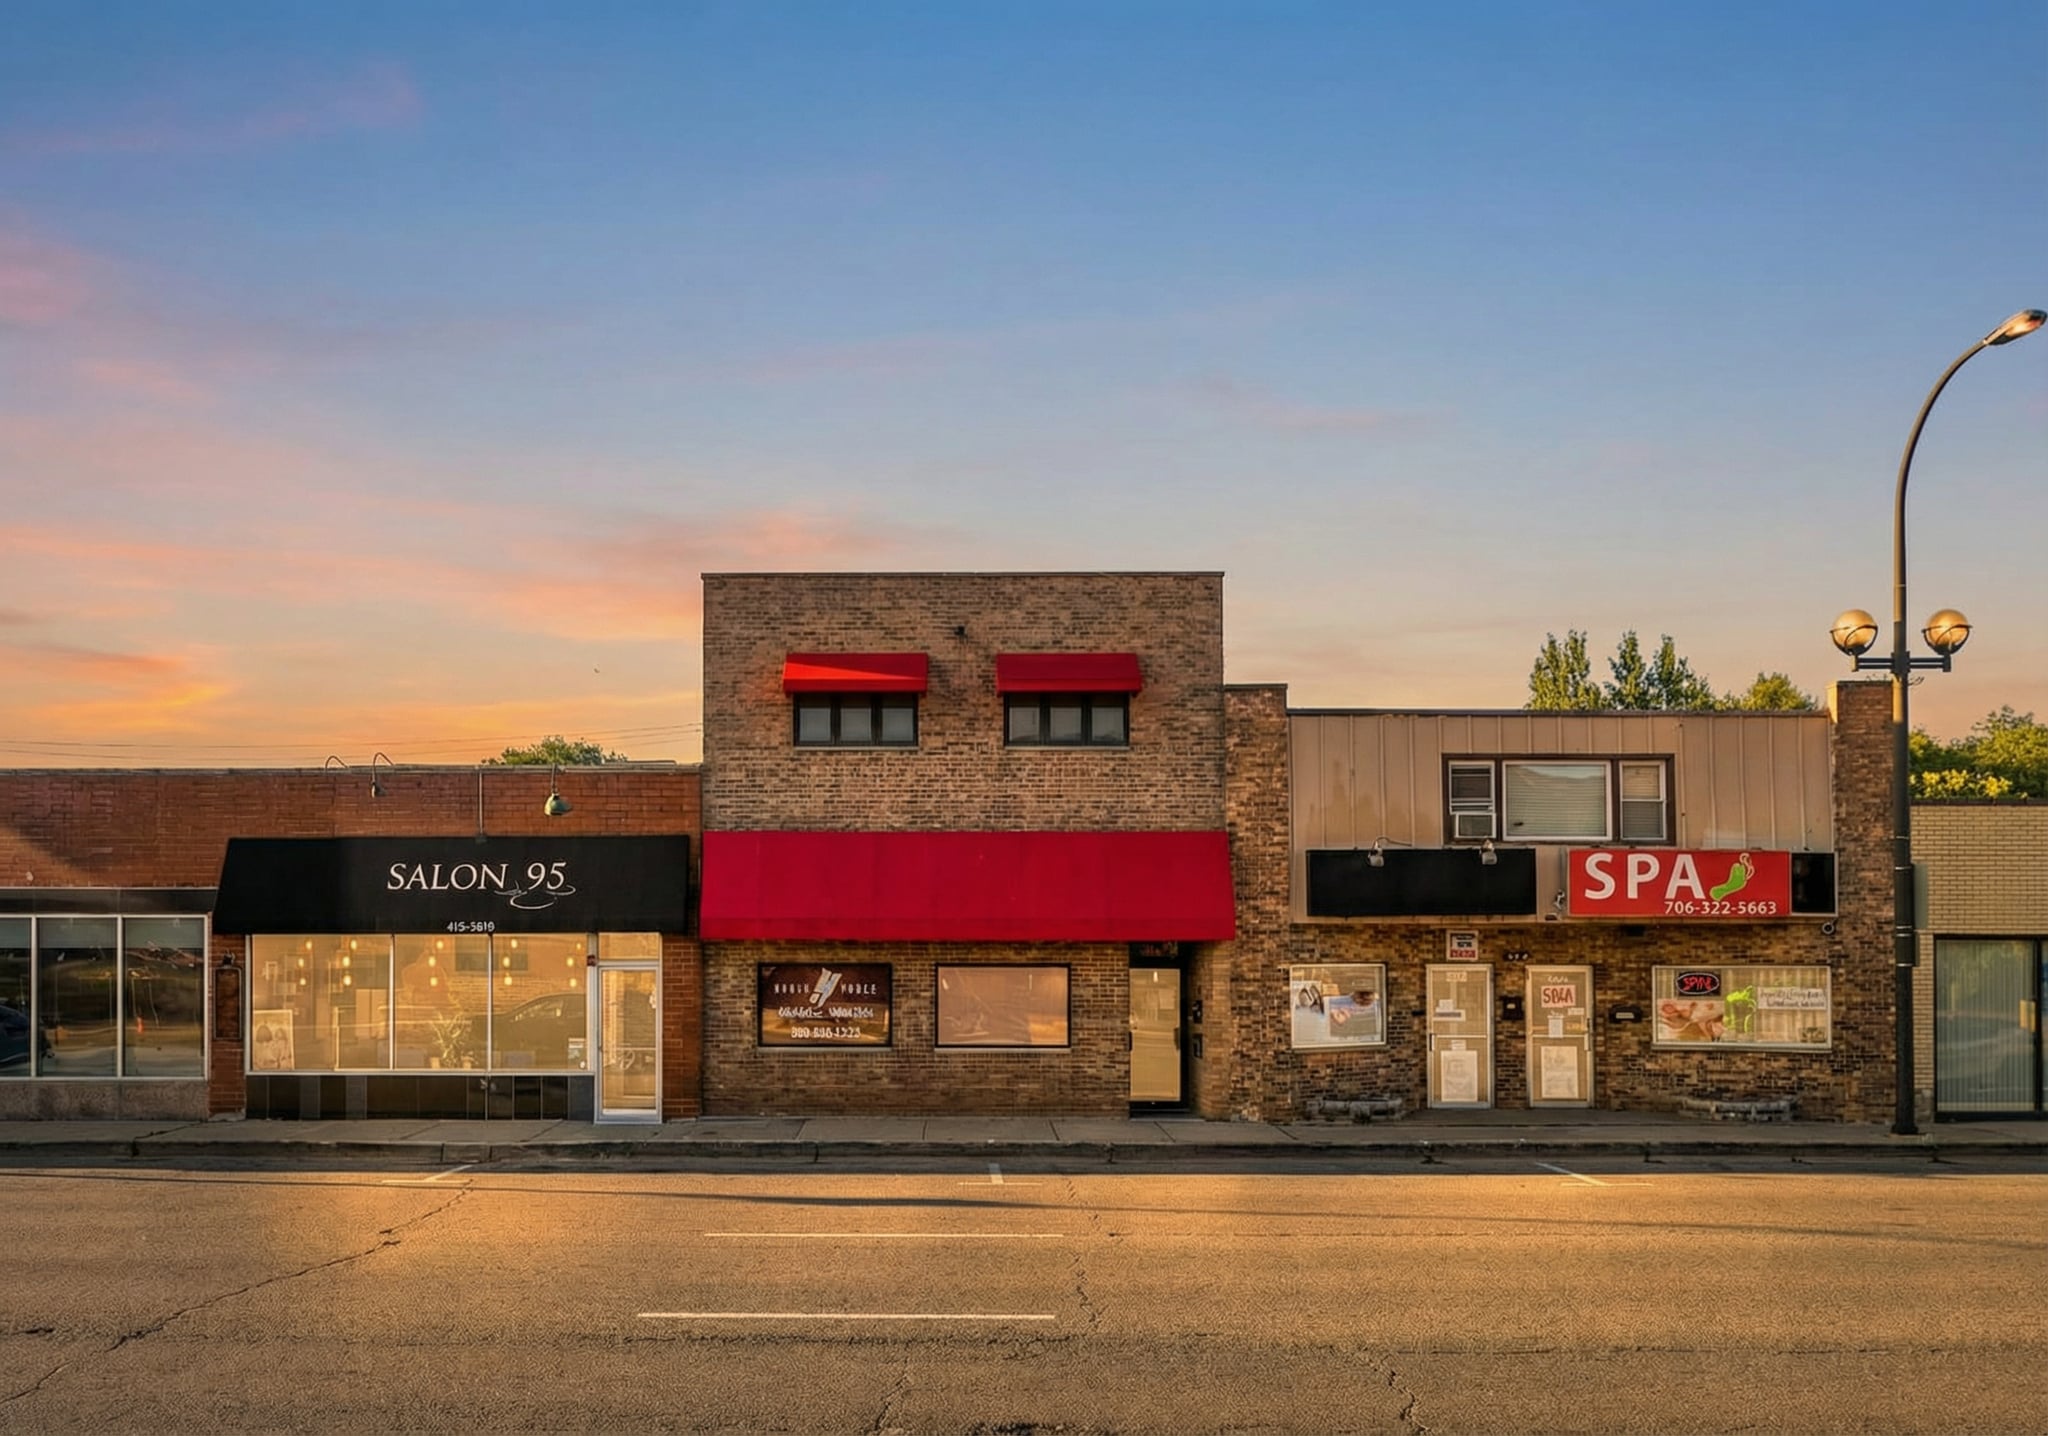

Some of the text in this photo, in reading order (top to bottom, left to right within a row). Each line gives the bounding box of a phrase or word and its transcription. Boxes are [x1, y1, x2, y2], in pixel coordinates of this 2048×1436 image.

[387, 861, 567, 890] SALON 95
[1584, 852, 1706, 900] SPA
[1664, 901, 1777, 915] 706-322-5663
